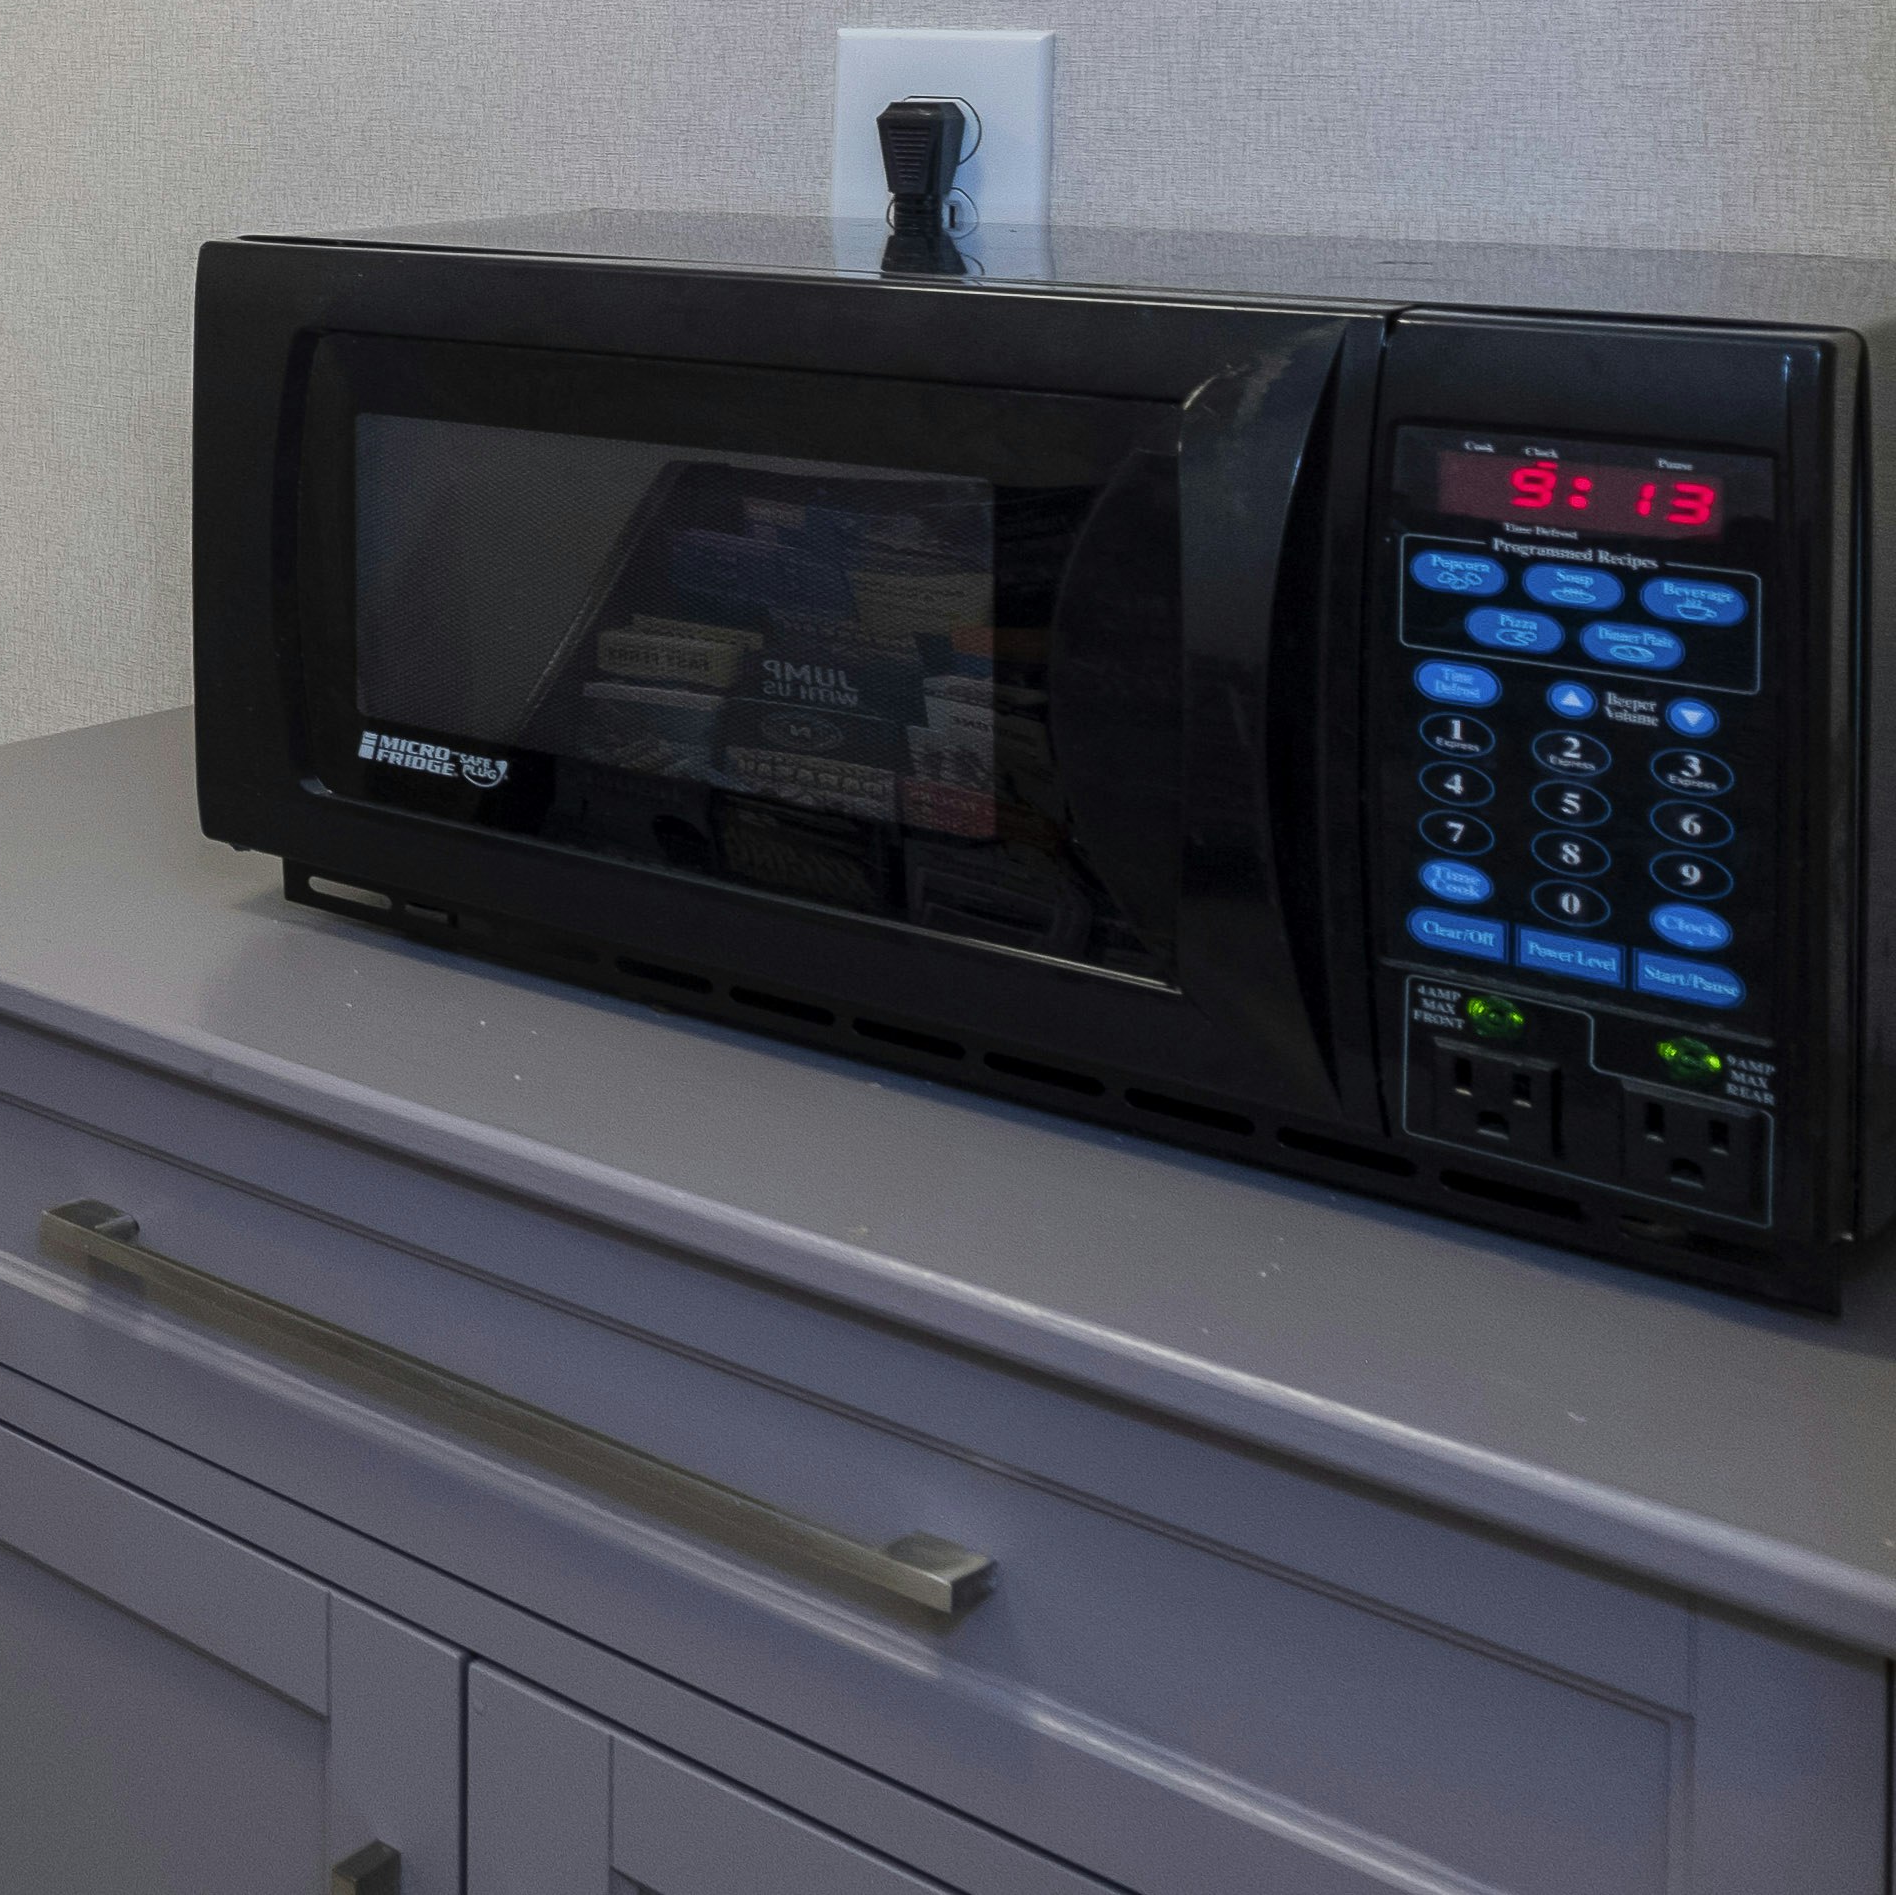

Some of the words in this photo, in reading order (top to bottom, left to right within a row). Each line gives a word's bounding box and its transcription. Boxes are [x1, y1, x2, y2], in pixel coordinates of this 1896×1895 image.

[1511, 465, 1716, 525] 9:13
[1429, 554, 1491, 574] Popcorn
[1492, 537, 1594, 563] Programmed
[1598, 549, 1659, 571] Recipes
[1555, 569, 1594, 588] Soup
[1663, 581, 1735, 604] Beverage
[1606, 690, 1658, 713] Beeper
[1604, 704, 1660, 727] Volume
[1450, 718, 1463, 739] 1
[378, 733, 452, 763] MICRO
[1435, 736, 1481, 754] Express
[1562, 736, 1582, 759] 2
[375, 748, 457, 778] FRIDGE
[459, 752, 494, 770] SAFE
[1548, 754, 1597, 772] Express
[1681, 754, 1702, 778] 3
[461, 764, 499, 782] PLUG
[1443, 773, 1464, 795] 4
[1667, 774, 1719, 792] Express
[1561, 792, 1582, 816] 5
[1446, 821, 1465, 844] 7
[1679, 814, 1702, 837] 6
[1561, 842, 1582, 866] 8
[1679, 862, 1702, 887] 9
[1560, 892, 1581, 916] 0
[1422, 918, 1497, 949] Clear/Off
[1659, 913, 1724, 942] Clock
[1527, 940, 1575, 965] Power
[1576, 947, 1618, 974] Level
[1643, 963, 1740, 999] Start/Pause
[1421, 998, 1457, 1018] MAX
[1412, 1009, 1467, 1032] FRONT
[1728, 1069, 1770, 1091] MAX
[1725, 1082, 1776, 1107] REAR
